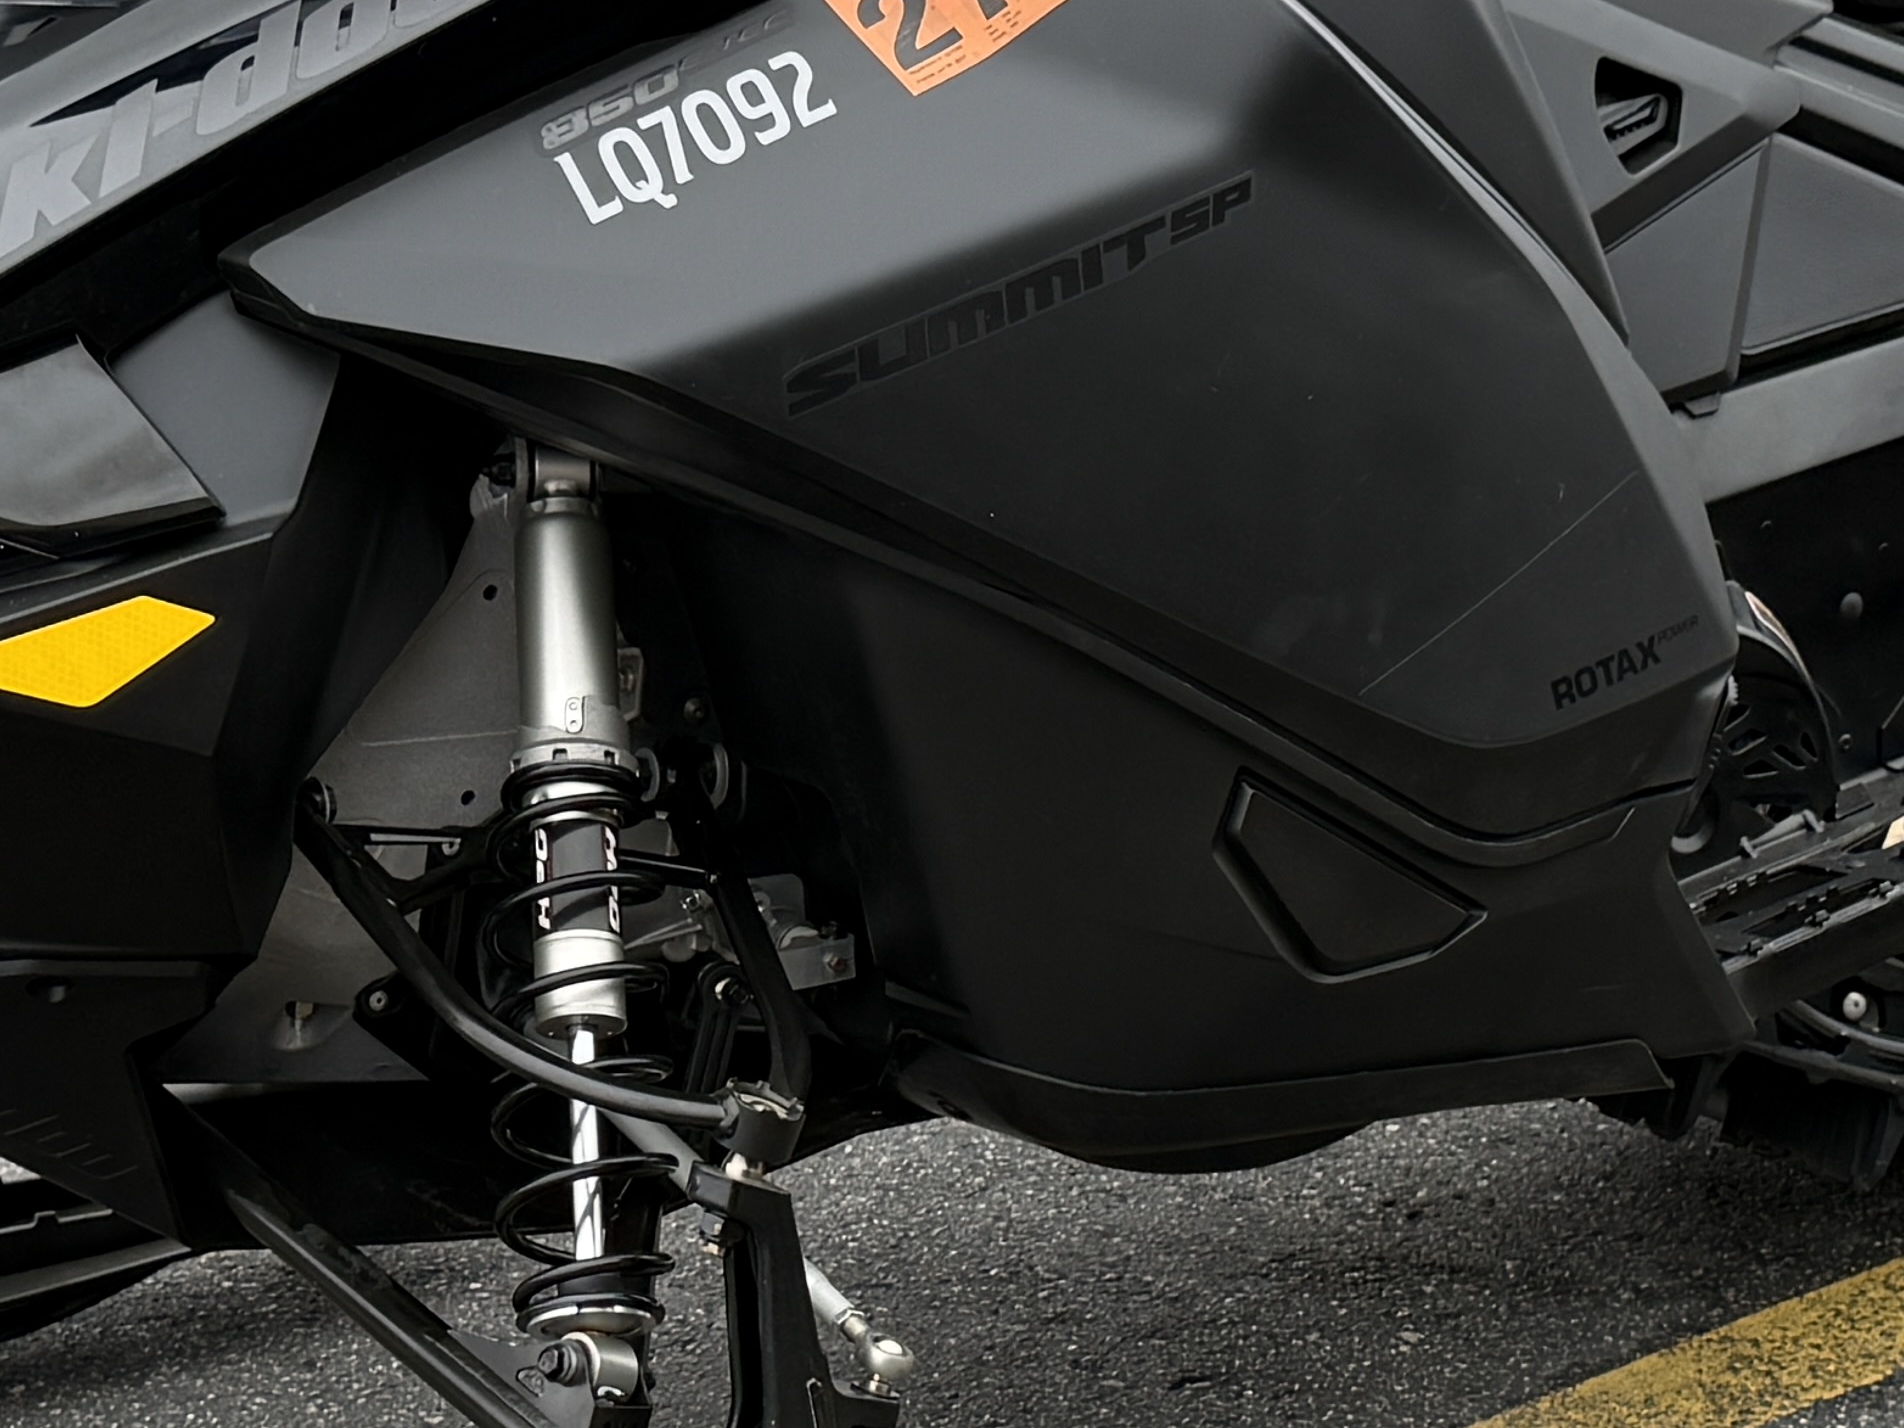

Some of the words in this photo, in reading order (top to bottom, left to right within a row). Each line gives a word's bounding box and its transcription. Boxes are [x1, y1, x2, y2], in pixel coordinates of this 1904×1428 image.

[540, 65, 680, 150] 850
[553, 50, 838, 225] LQ7092
[784, 212, 1167, 420] SUMMIT
[1168, 171, 1255, 247] SP
[1551, 633, 1662, 710] ROTAX
